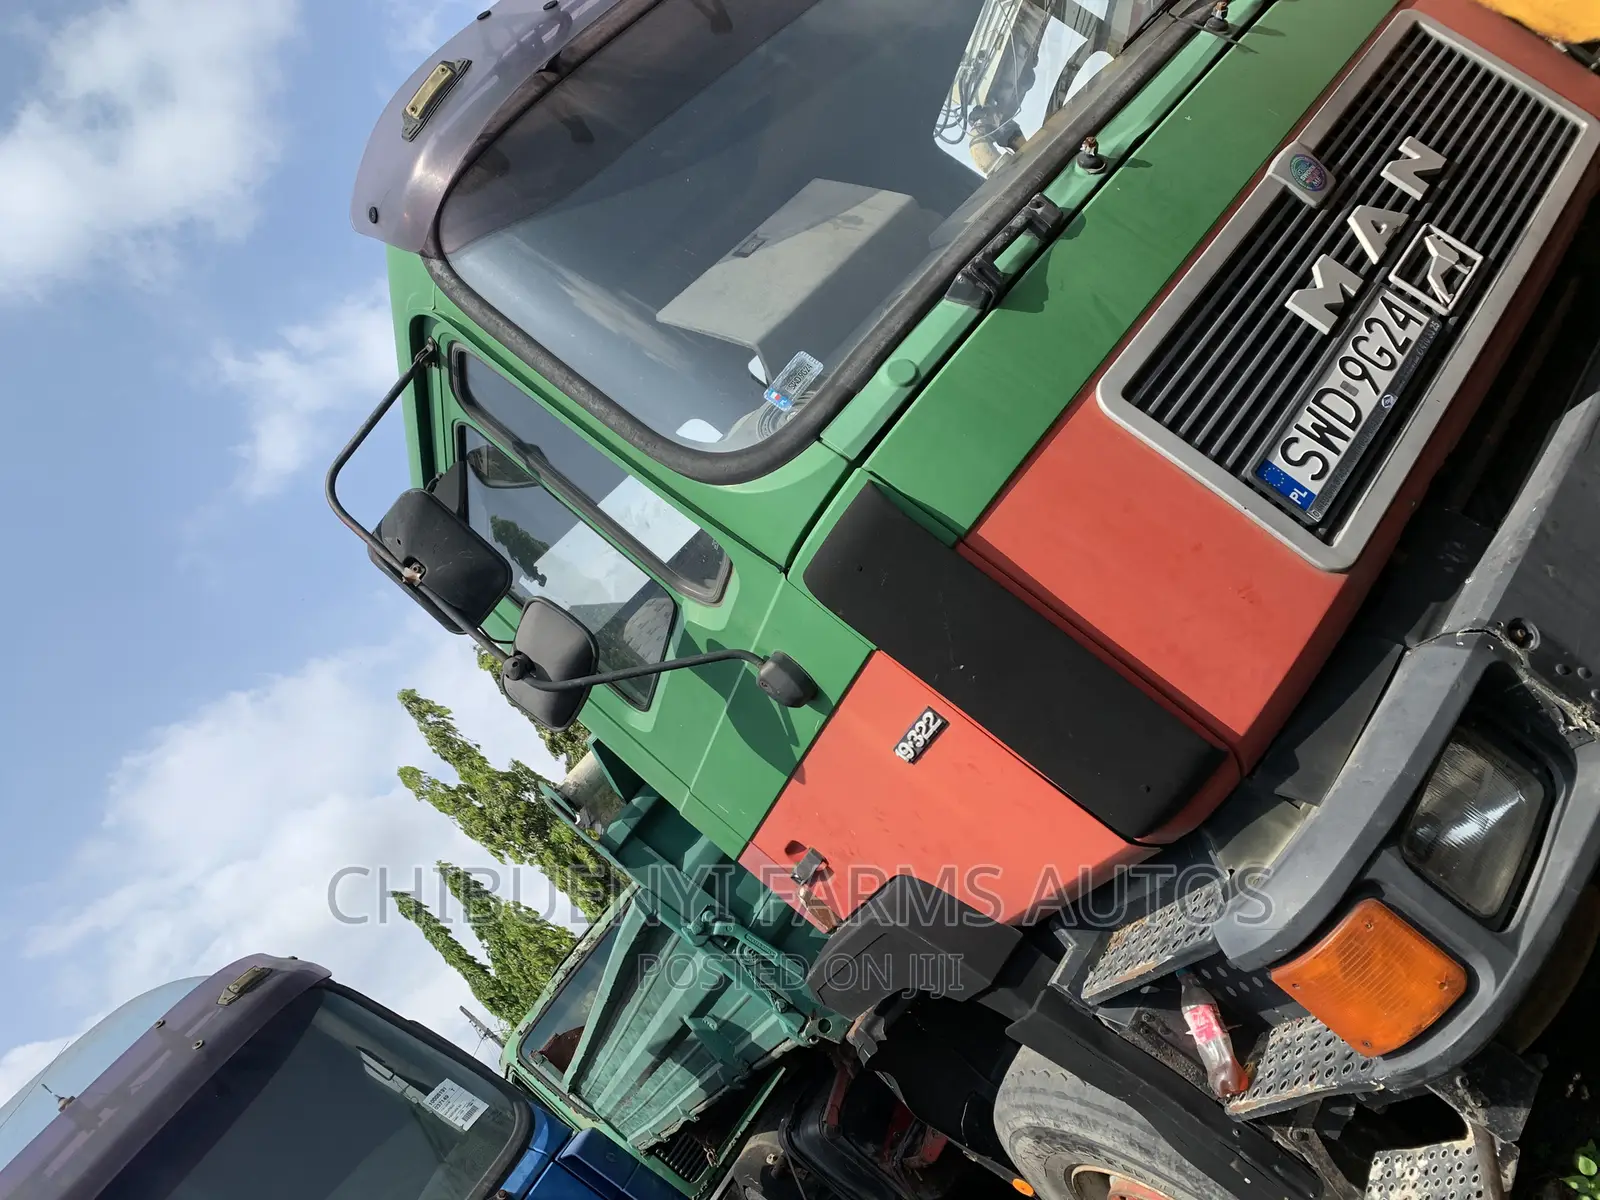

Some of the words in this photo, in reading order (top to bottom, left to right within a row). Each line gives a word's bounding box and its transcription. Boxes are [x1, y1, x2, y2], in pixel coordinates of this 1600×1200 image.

[1285, 135, 1447, 336] MAN
[1279, 386, 1363, 481] SWD
[1338, 295, 1424, 396] 9G24
[1289, 488, 1308, 505] PL
